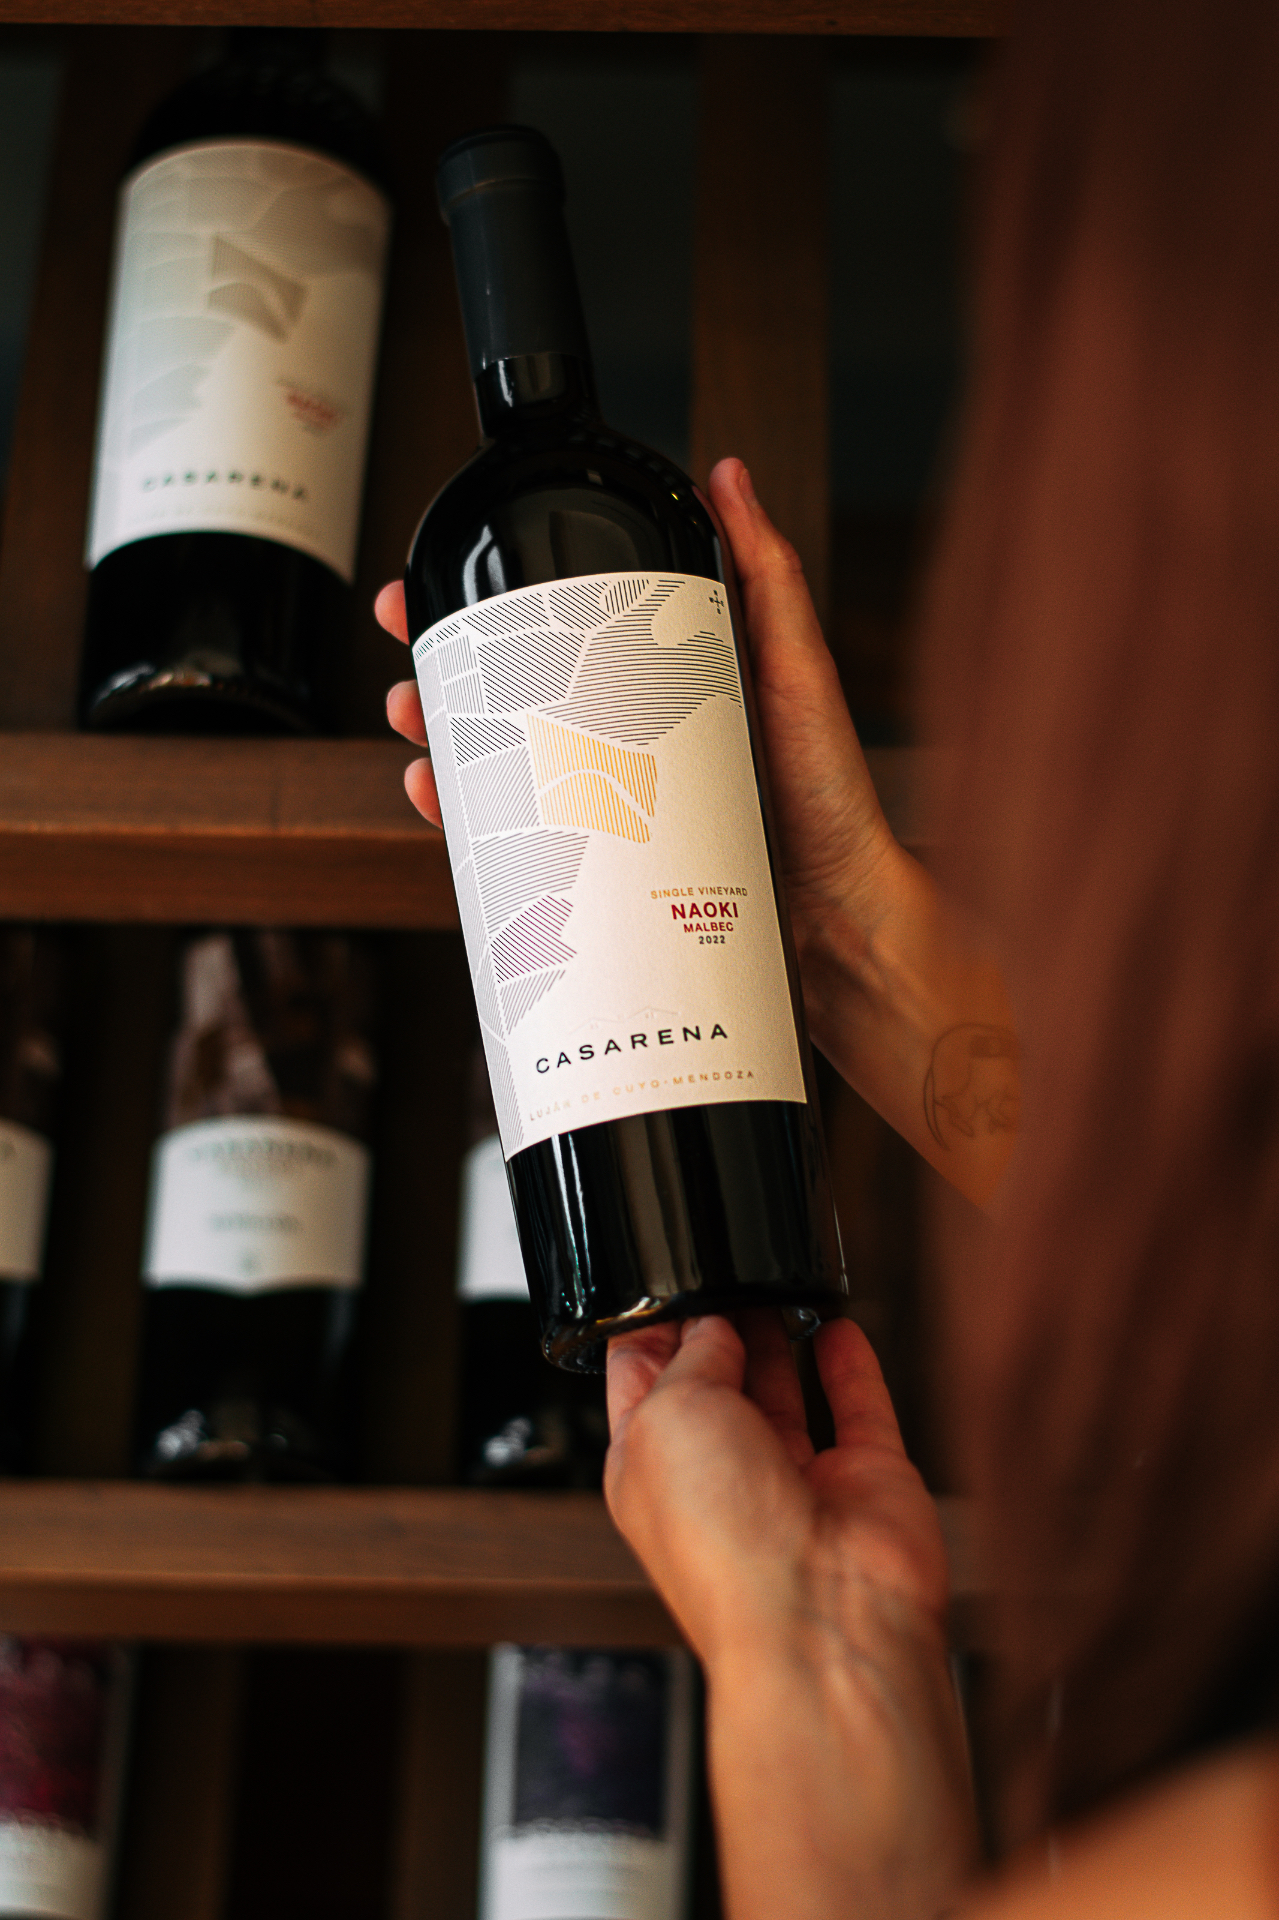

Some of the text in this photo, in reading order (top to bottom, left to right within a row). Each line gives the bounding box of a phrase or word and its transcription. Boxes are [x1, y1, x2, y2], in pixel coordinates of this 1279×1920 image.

[650, 886, 748, 899] SINGLE VINEYARD
[670, 901, 739, 920] NAOKI
[683, 921, 734, 933] MALBEC
[698, 935, 726, 945] 2022
[535, 1023, 728, 1074] CASARENA
[581, 1091, 601, 1104] DE
